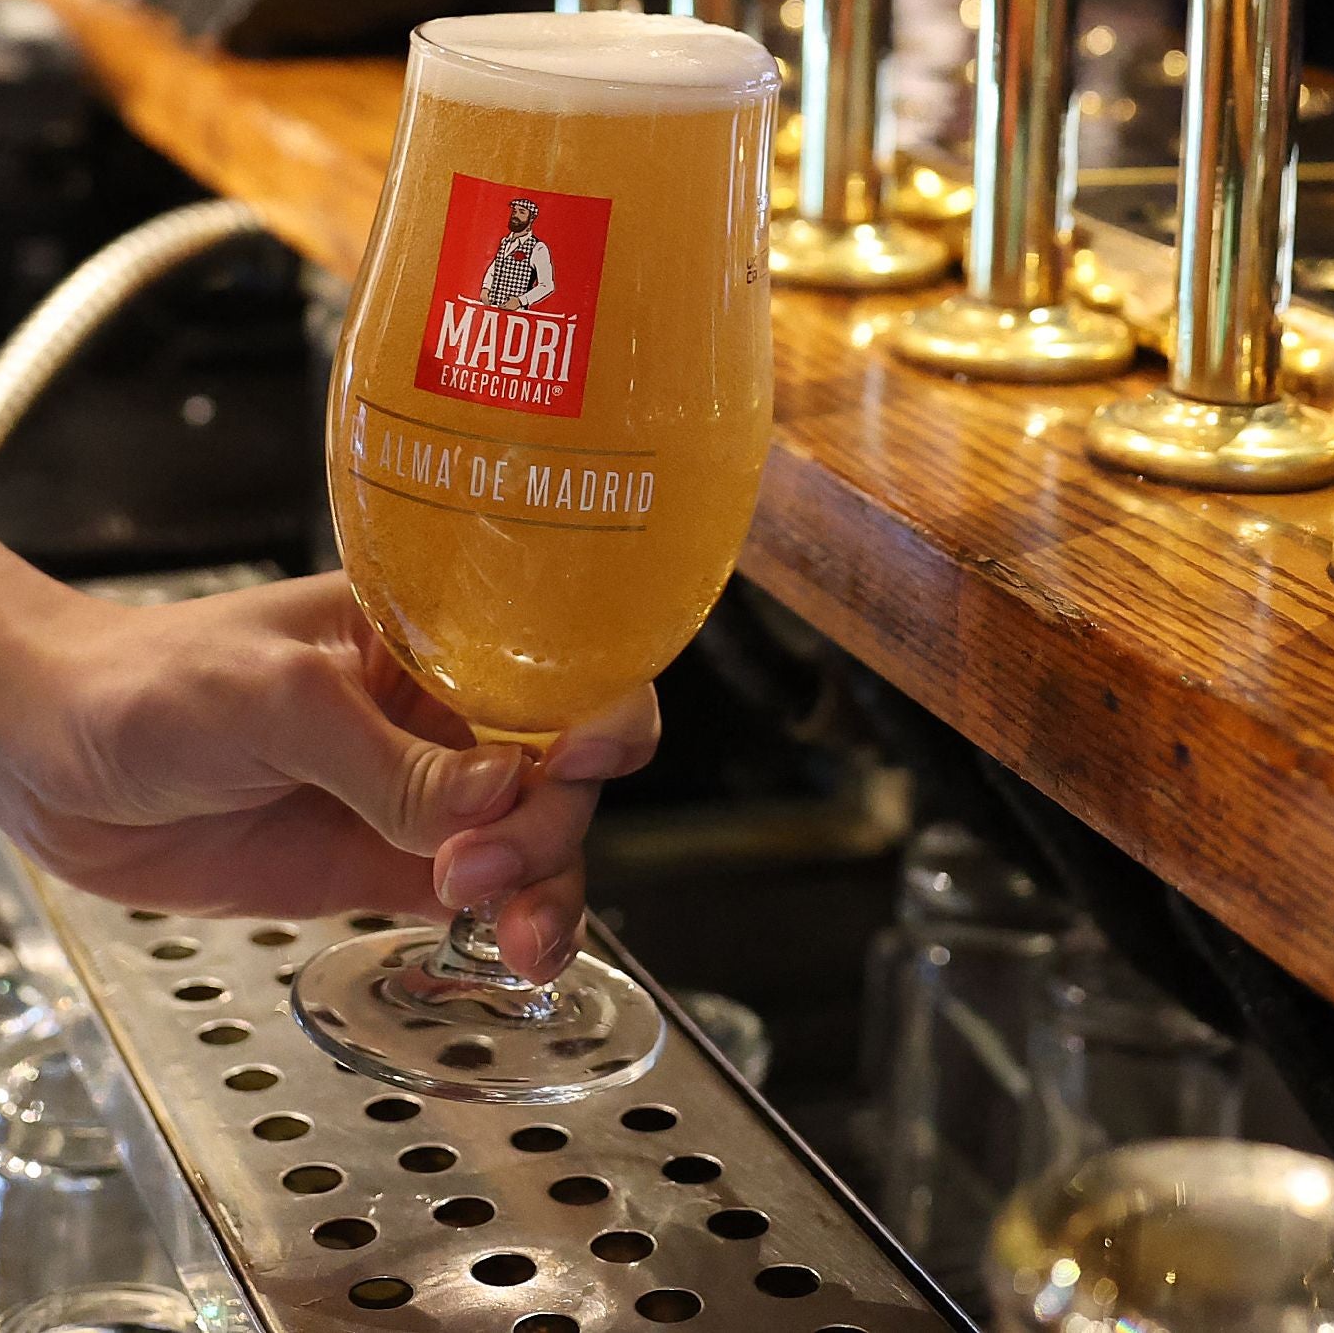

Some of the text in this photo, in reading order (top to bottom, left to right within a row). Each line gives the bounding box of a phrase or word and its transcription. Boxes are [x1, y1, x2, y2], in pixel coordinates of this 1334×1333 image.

[434, 300, 578, 382] MADRÍ
[379, 429, 451, 490] ALMA
[469, 456, 508, 502] DE
[525, 465, 656, 513] MADRID
